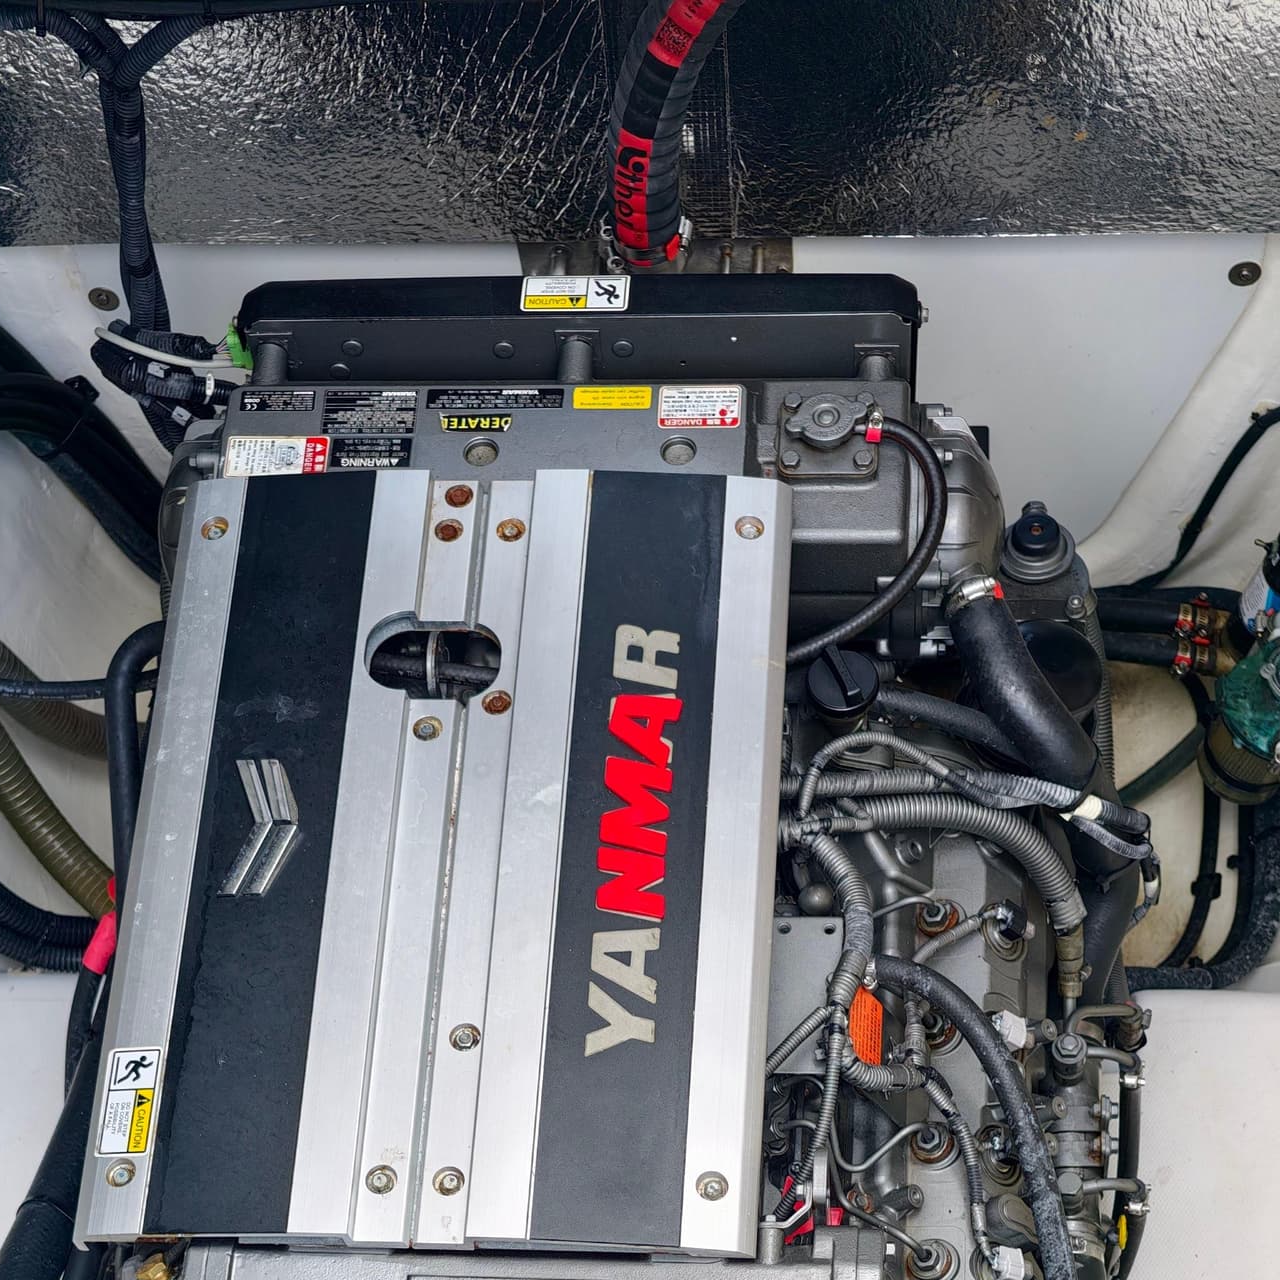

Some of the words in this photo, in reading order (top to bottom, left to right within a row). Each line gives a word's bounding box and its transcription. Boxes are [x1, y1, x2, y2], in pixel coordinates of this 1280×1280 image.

[304, 443, 314, 472] DANGER
[340, 458, 390, 467] WARNING
[584, 623, 685, 1059] YANMAR
[133, 1109, 145, 1149] CAUTION
